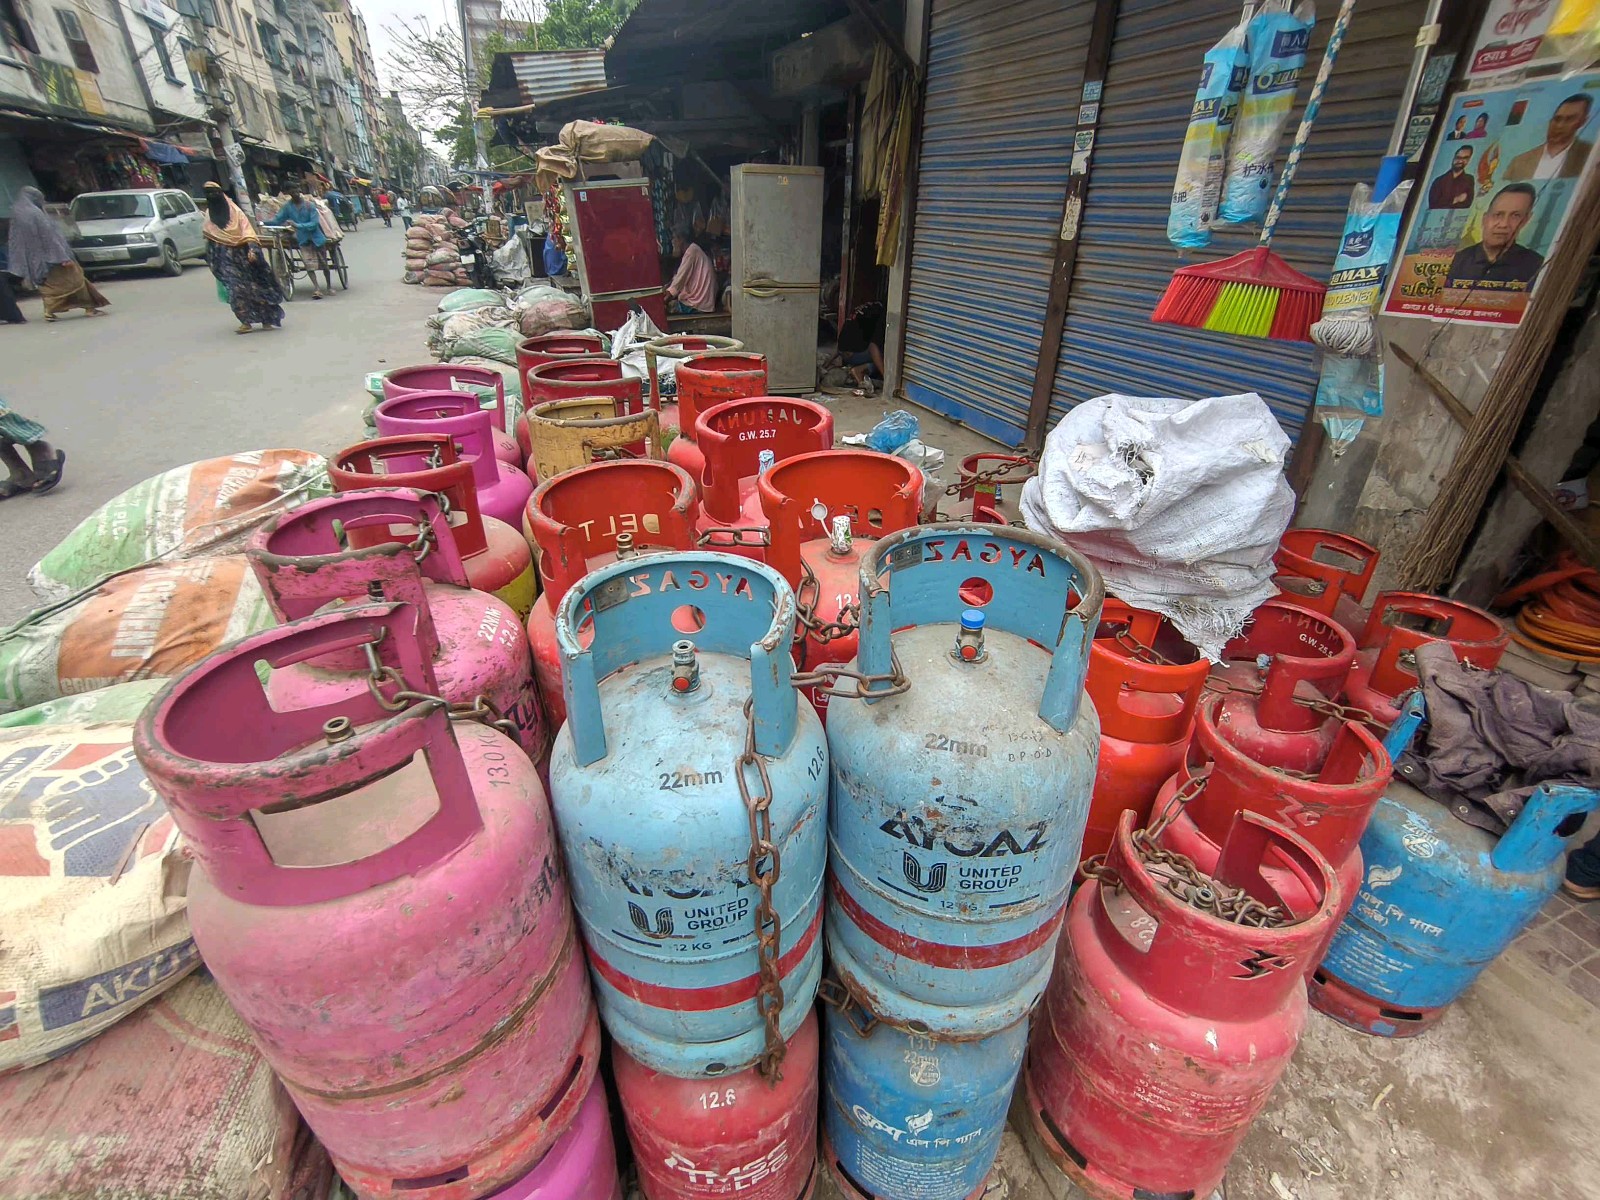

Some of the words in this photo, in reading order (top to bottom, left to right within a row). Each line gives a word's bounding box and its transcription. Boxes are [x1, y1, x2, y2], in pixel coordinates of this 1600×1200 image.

[739, 431, 758, 441] G.W.
[759, 429, 777, 439] 25.7
[925, 732, 988, 758] 22mm
[483, 751, 511, 787] 13.0
[807, 746, 825, 782] 12.6
[659, 770, 723, 791] 22mm
[959, 865, 1023, 879] UNITED
[959, 877, 1020, 890] GROUP
[684, 898, 750, 919] UNITED
[687, 909, 749, 931] GROUP
[691, 941, 712, 951] KG
[699, 1088, 736, 1112] 12.6
